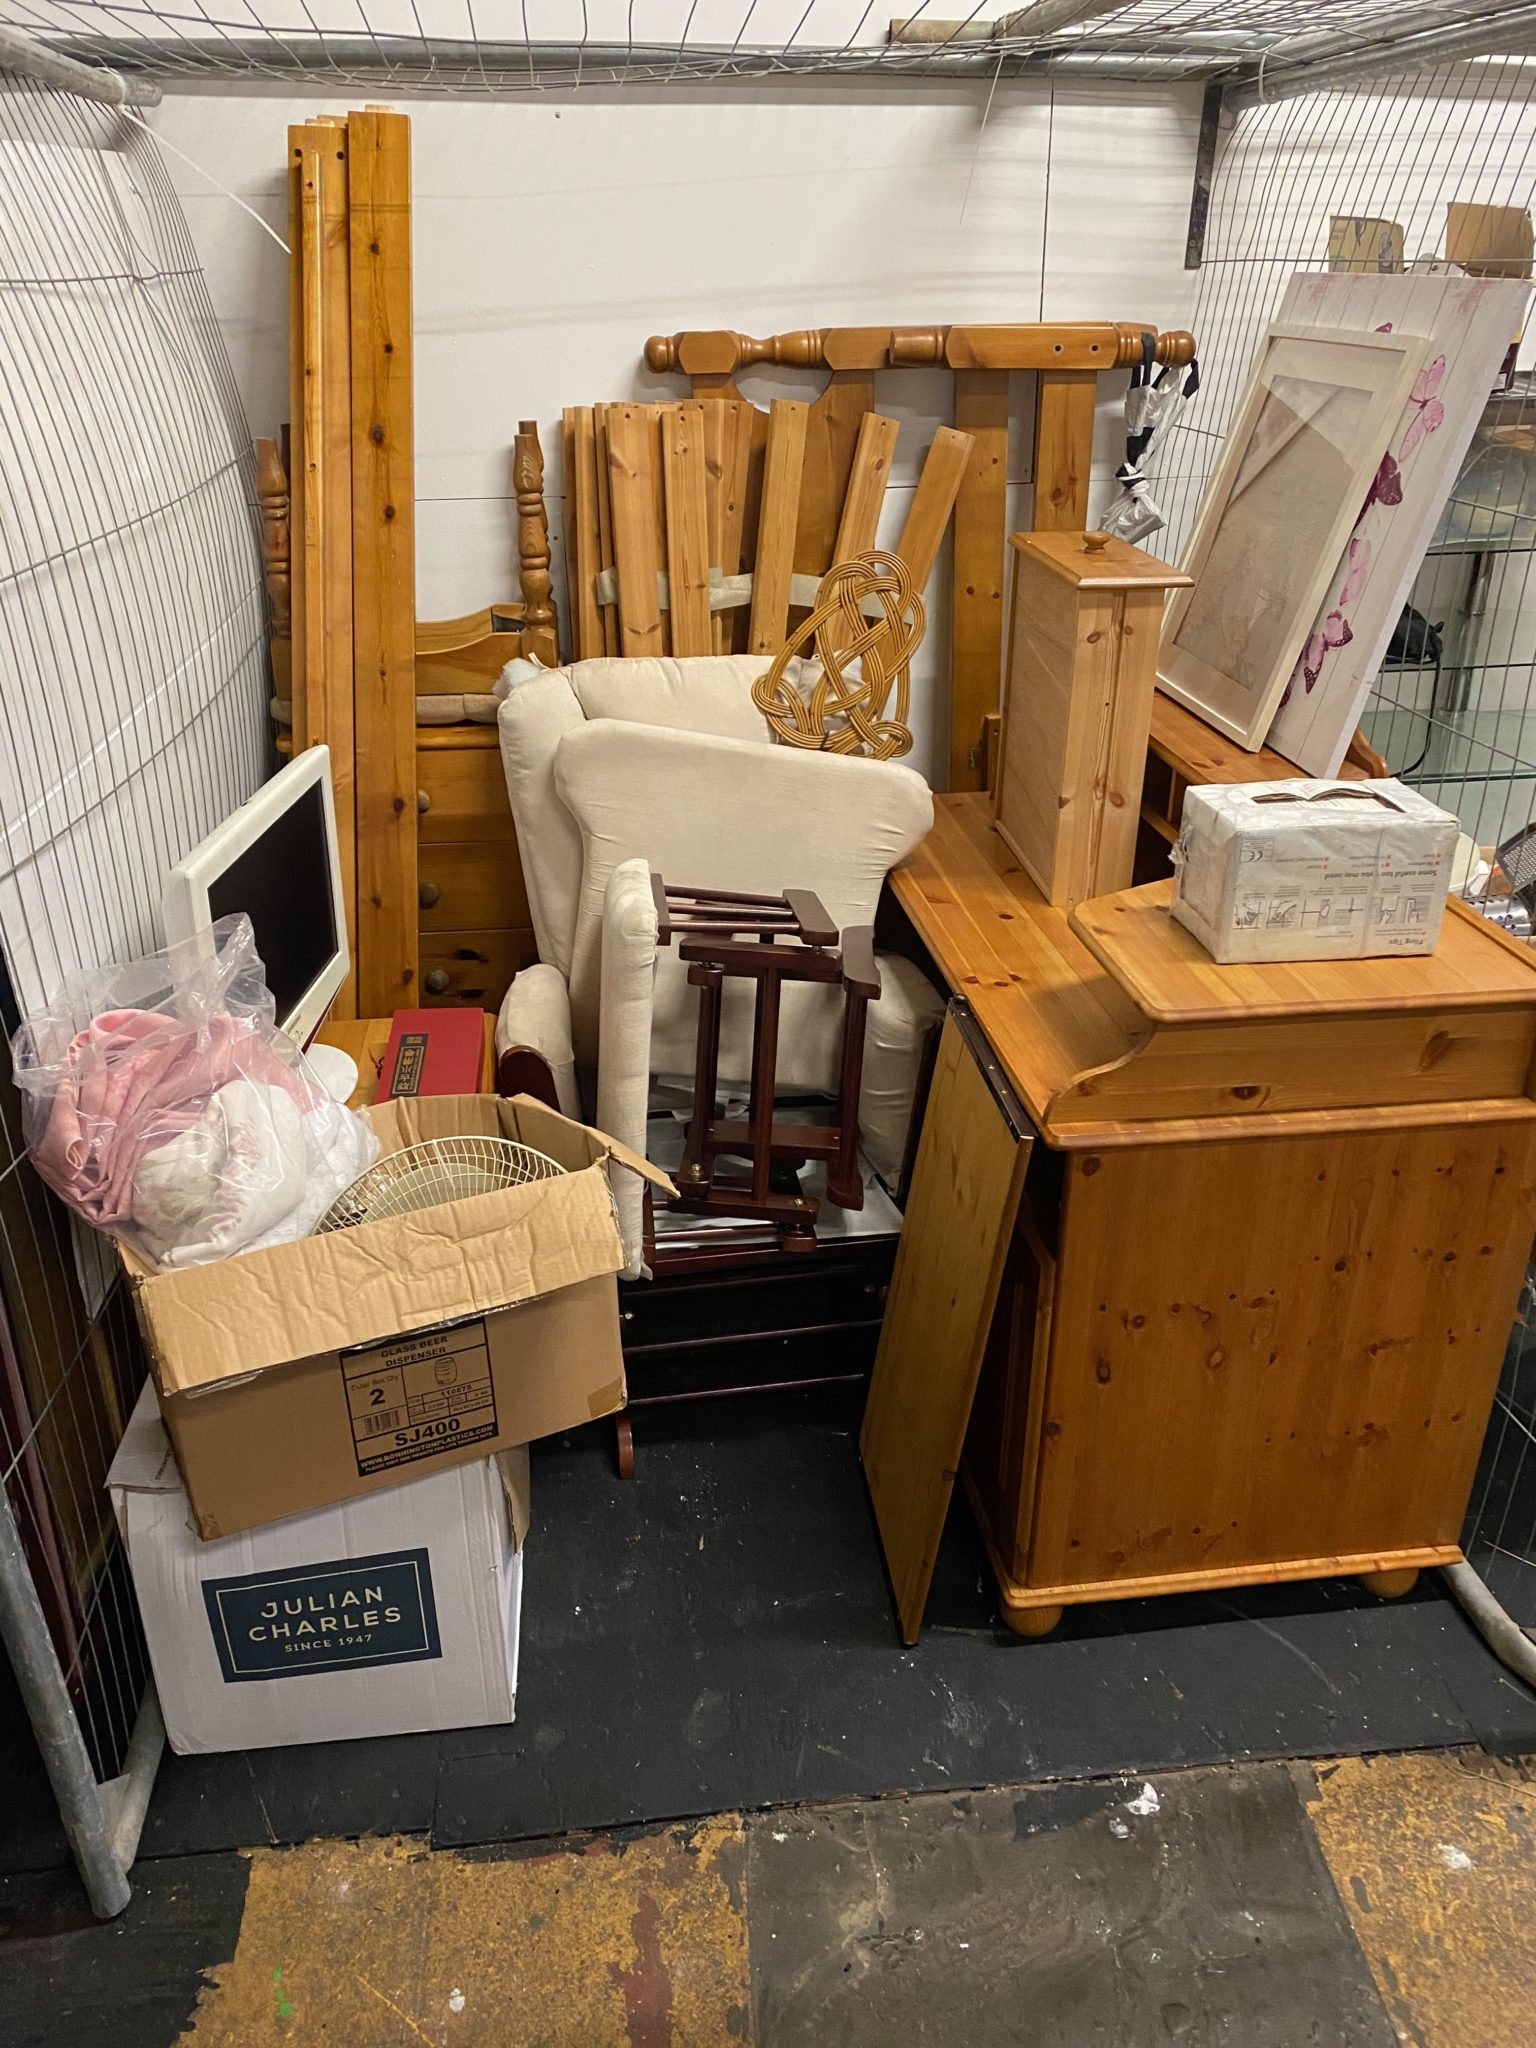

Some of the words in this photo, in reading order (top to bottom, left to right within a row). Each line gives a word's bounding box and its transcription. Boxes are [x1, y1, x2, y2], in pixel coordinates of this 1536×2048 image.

[1394, 870, 1417, 878] useful
[381, 1343, 417, 1358] GLASS
[418, 1335, 448, 1348] BEER
[385, 1346, 447, 1367] DISPENSER
[369, 1388, 386, 1407] 2
[395, 1418, 460, 1447] SJ400
[360, 1425, 494, 1468] WWW.BONNINGTONPLASTICS.COM
[260, 1585, 383, 1619] JULIAN
[248, 1606, 401, 1642] CHARLES
[284, 1639, 332, 1653] SINCE
[338, 1633, 373, 1646] 1947
